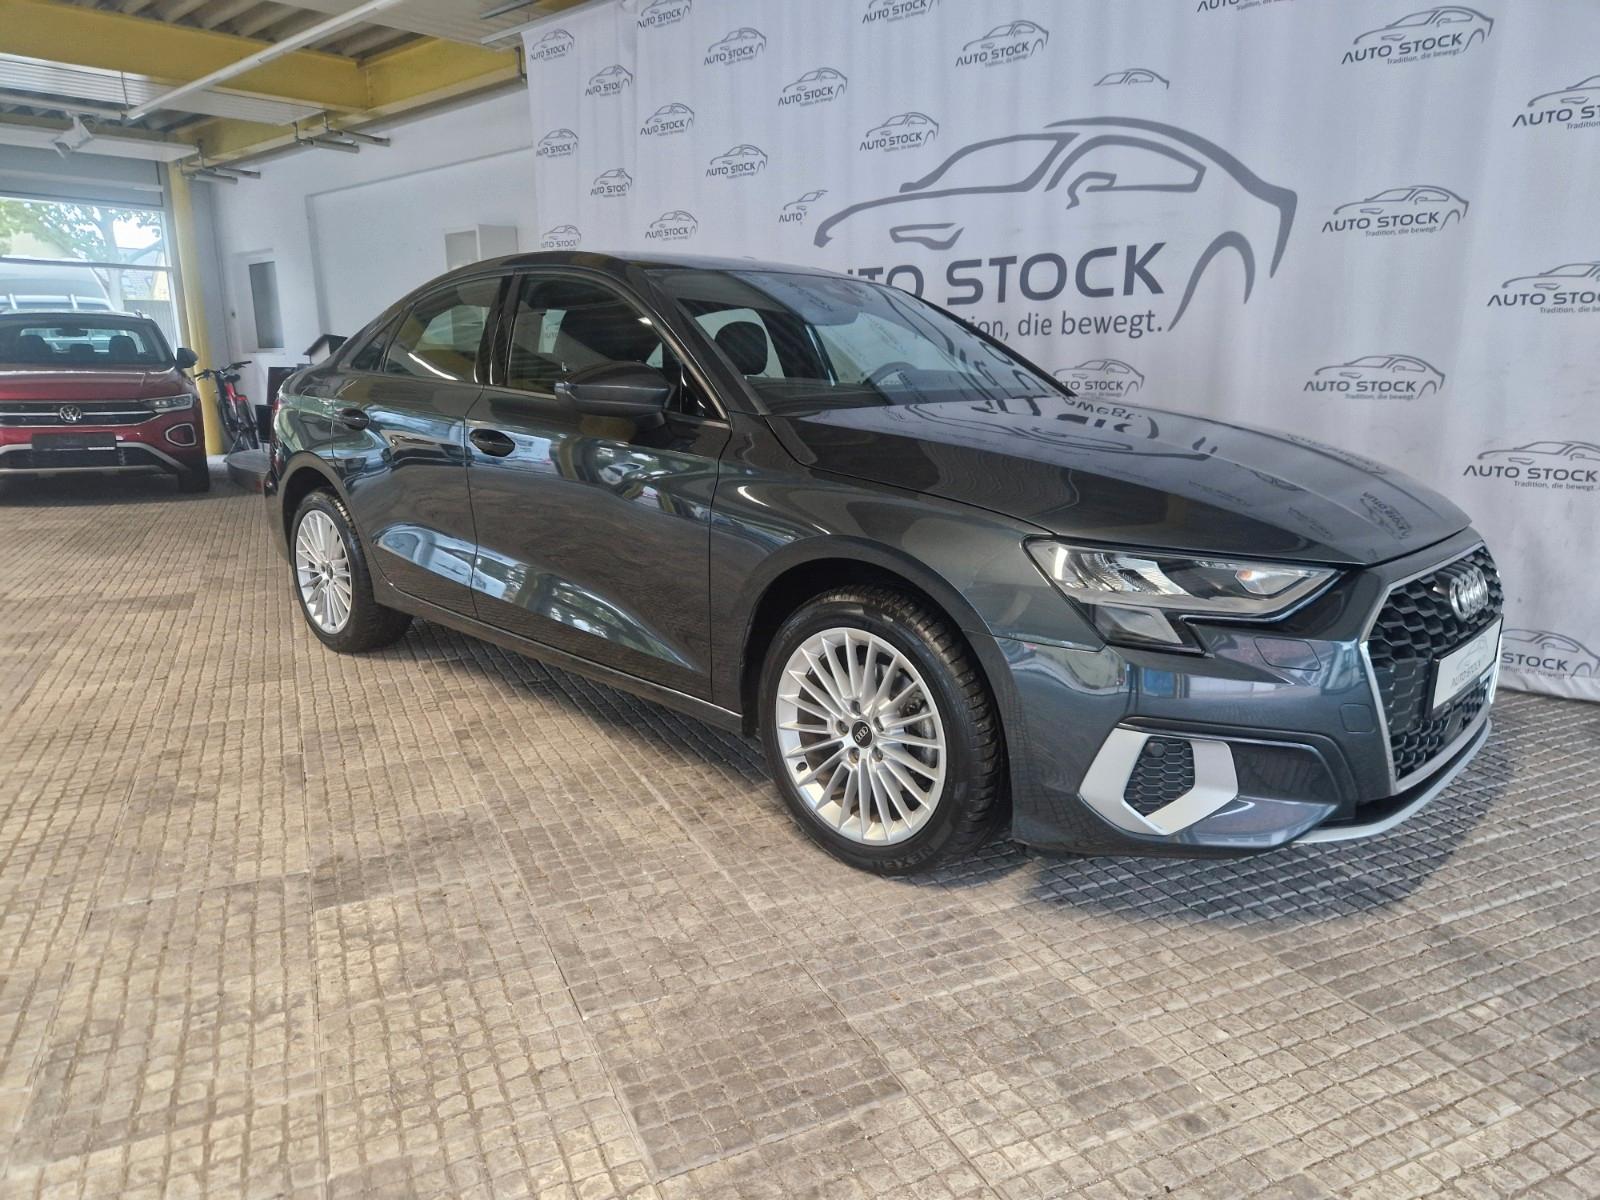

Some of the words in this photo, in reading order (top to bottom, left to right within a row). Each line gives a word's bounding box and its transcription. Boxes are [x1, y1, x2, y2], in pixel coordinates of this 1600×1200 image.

[637, 16, 656, 29] AUTO
[657, 8, 681, 23] STOCK
[862, 8, 889, 24] AUTO
[892, 0, 927, 16] STOCK
[545, 44, 566, 56] STOCK
[704, 53, 727, 66] AUTO
[728, 45, 755, 60] STOCK
[955, 51, 988, 67] AUTO
[991, 41, 1030, 60] STOCK
[1341, 45, 1393, 65] AUTO
[1398, 32, 1464, 56] STOCK
[778, 93, 802, 107] AUTO
[803, 86, 834, 101] STOCK
[661, 119, 686, 132] STOCK
[1512, 108, 1573, 128] AUTO
[549, 143, 572, 154] STOCK
[860, 138, 887, 151] AUTO
[889, 132, 923, 146] STOCK
[705, 166, 729, 177] AUTO
[730, 161, 756, 174] STOCK
[779, 212, 803, 223] AUTO
[1322, 217, 1371, 233] AUTO
[1377, 211, 1440, 229] STOCK
[664, 226, 689, 238] STOCK
[556, 240, 577, 249] STOCK
[946, 242, 1167, 306] STOCK
[1487, 293, 1546, 307] AUTO
[1553, 291, 1600, 305] STO
[1018, 312, 1053, 337] die
[1061, 309, 1163, 340] bewegt.
[1084, 381, 1124, 391] STOCK
[1303, 380, 1351, 392] AUTO
[1356, 380, 1417, 393] STOCK
[1463, 464, 1520, 479] AUTO
[1527, 467, 1598, 483] STOCK
[1502, 652, 1568, 672] STOCK
